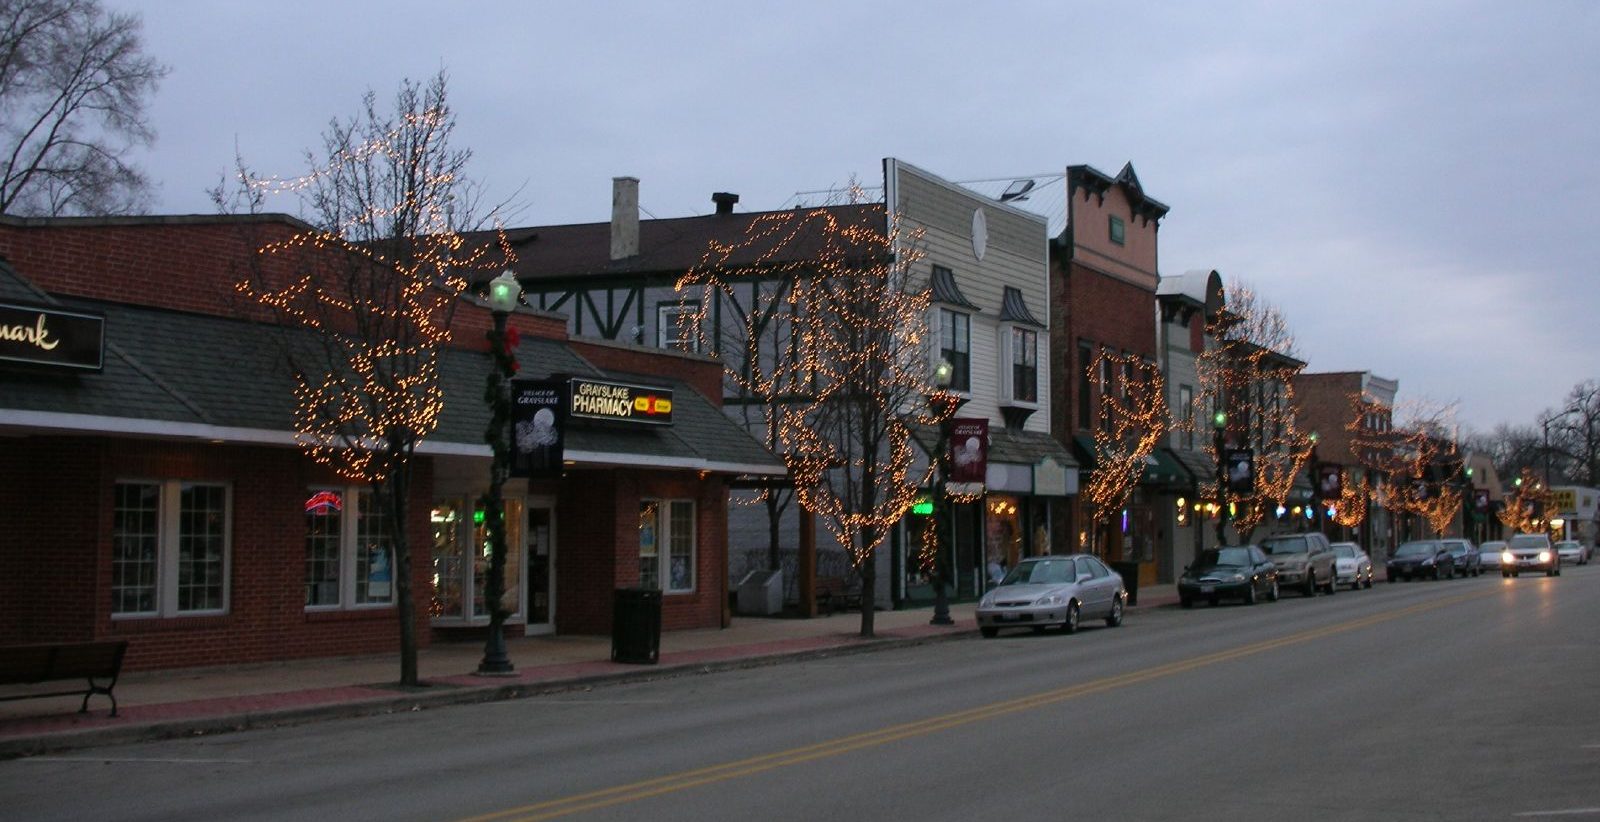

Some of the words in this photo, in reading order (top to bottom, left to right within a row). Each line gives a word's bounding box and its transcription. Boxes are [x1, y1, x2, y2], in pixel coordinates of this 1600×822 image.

[579, 384, 629, 399] GRAYSLAKE
[517, 396, 558, 404] GRAYSLAKE
[573, 395, 633, 416] PHARMACY
